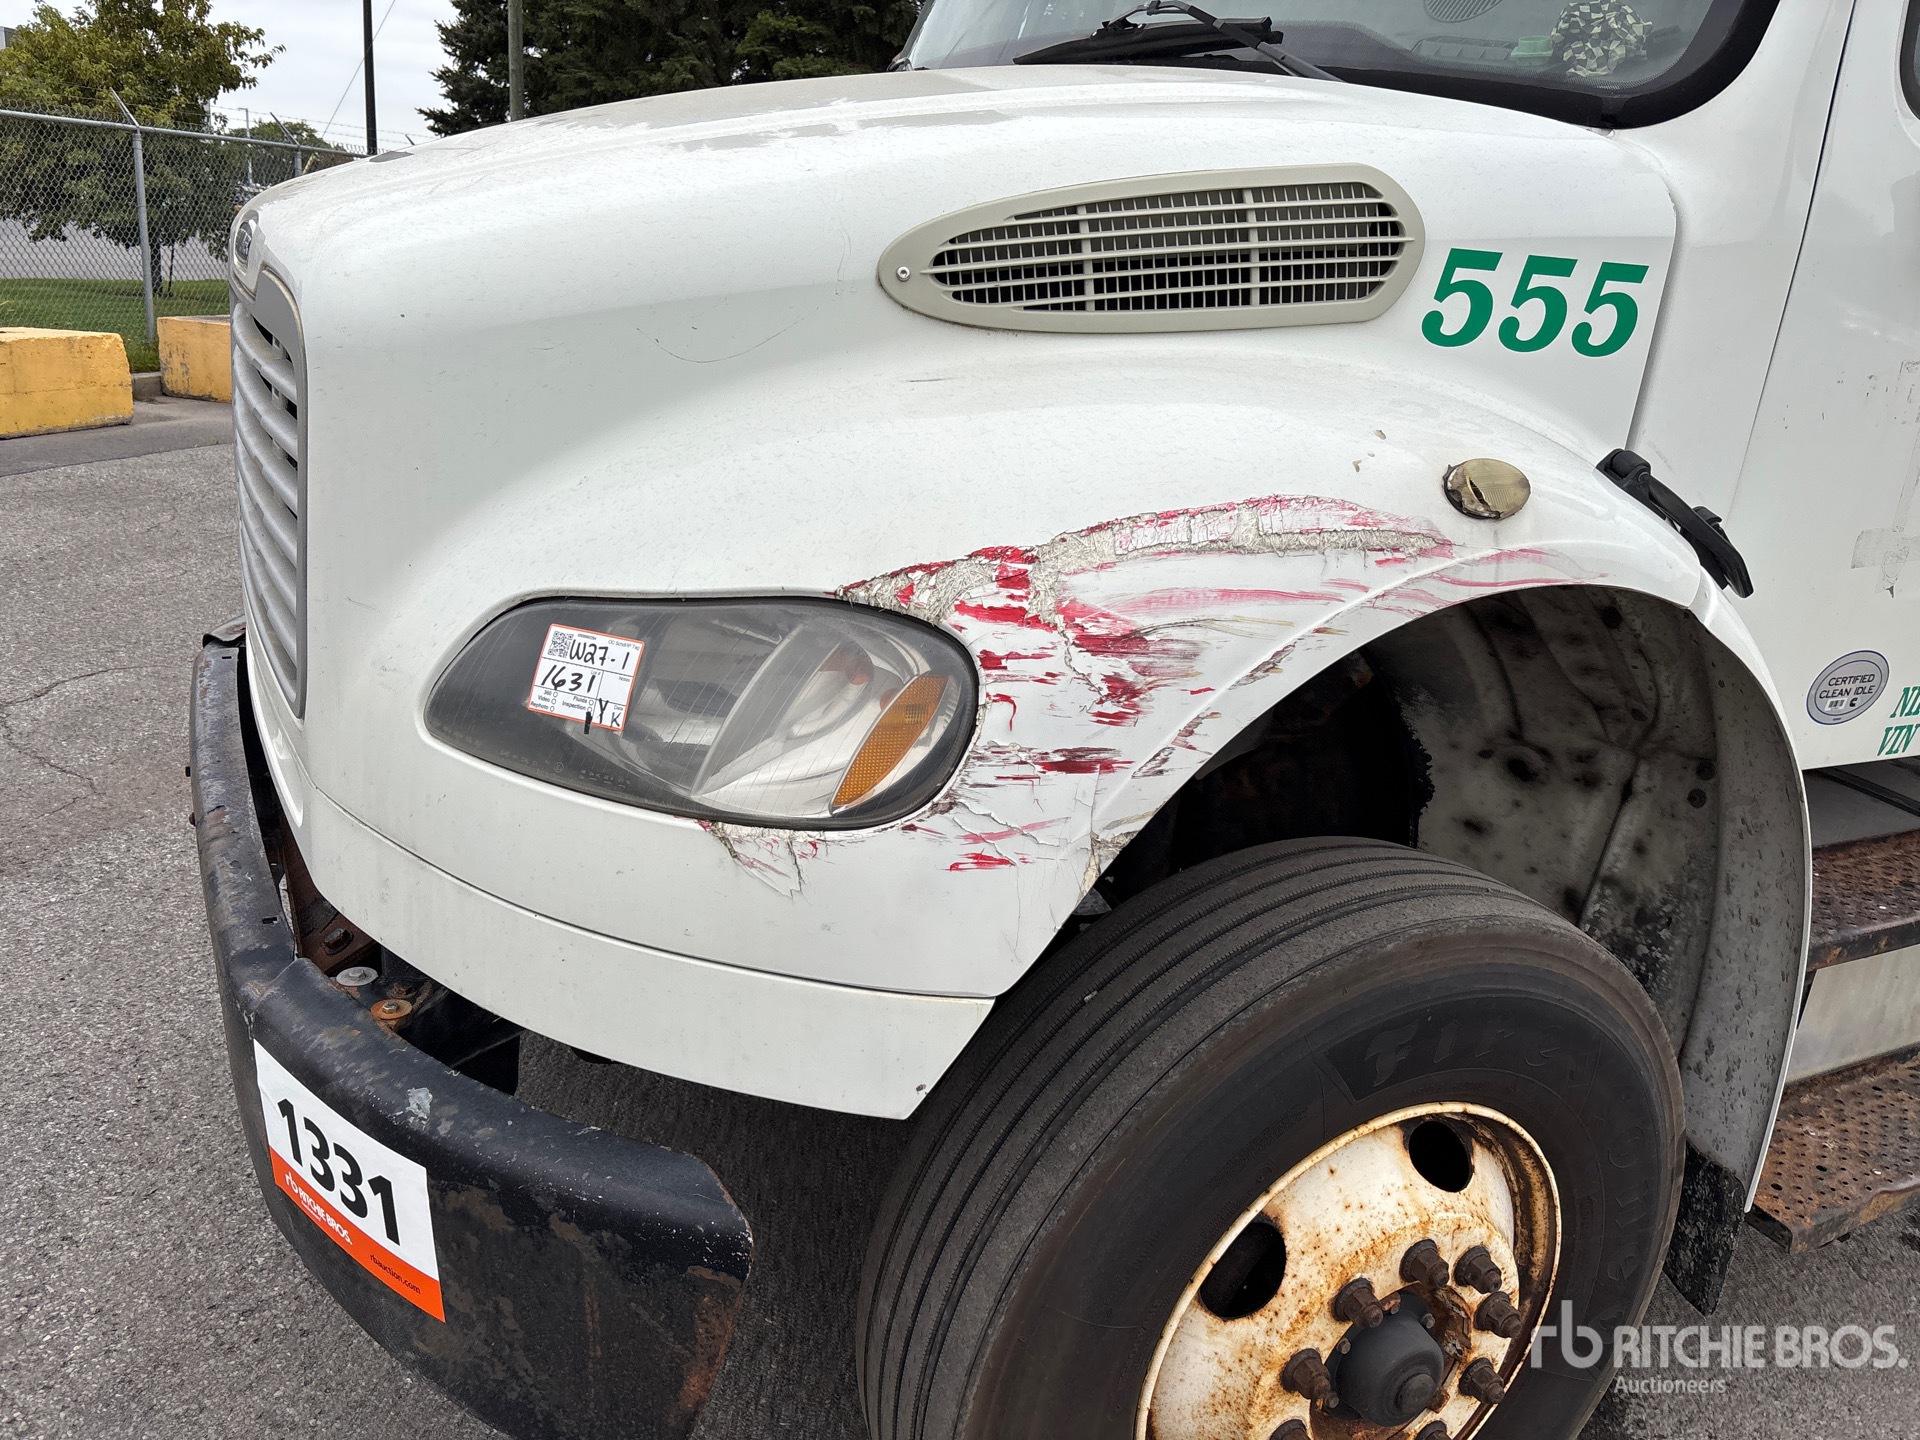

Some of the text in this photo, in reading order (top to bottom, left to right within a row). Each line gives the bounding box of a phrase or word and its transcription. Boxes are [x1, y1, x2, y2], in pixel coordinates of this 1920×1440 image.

[1421, 247, 1650, 358] 555
[541, 664, 596, 693] 1631
[1819, 685, 1875, 699] CLEAN IDLE
[1828, 674, 1875, 686] CERTIFIED
[277, 1099, 400, 1246] 1331
[370, 1254, 421, 1295] rbauction.com
